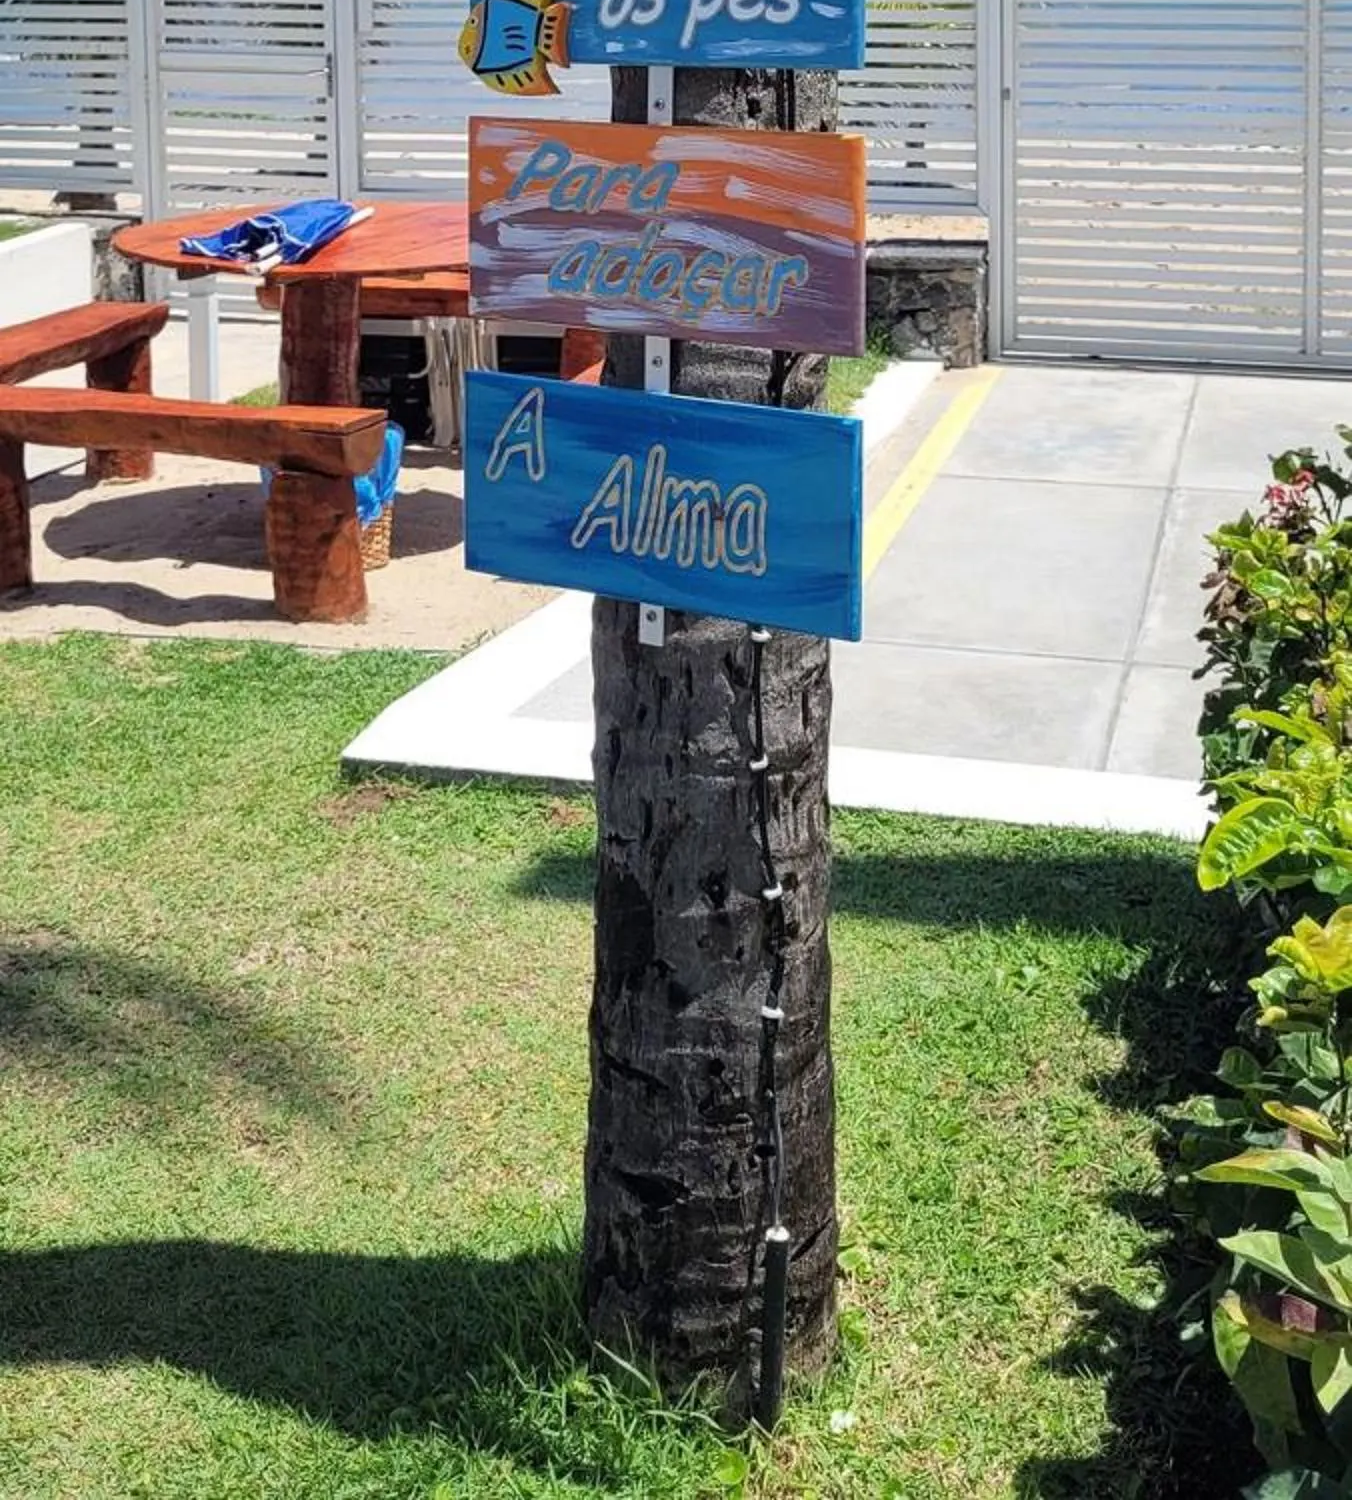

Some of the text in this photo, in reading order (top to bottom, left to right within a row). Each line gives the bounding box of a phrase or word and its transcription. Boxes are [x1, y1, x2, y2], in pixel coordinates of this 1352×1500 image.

[504, 140, 681, 212] Para
[485, 387, 768, 576] A Alma
